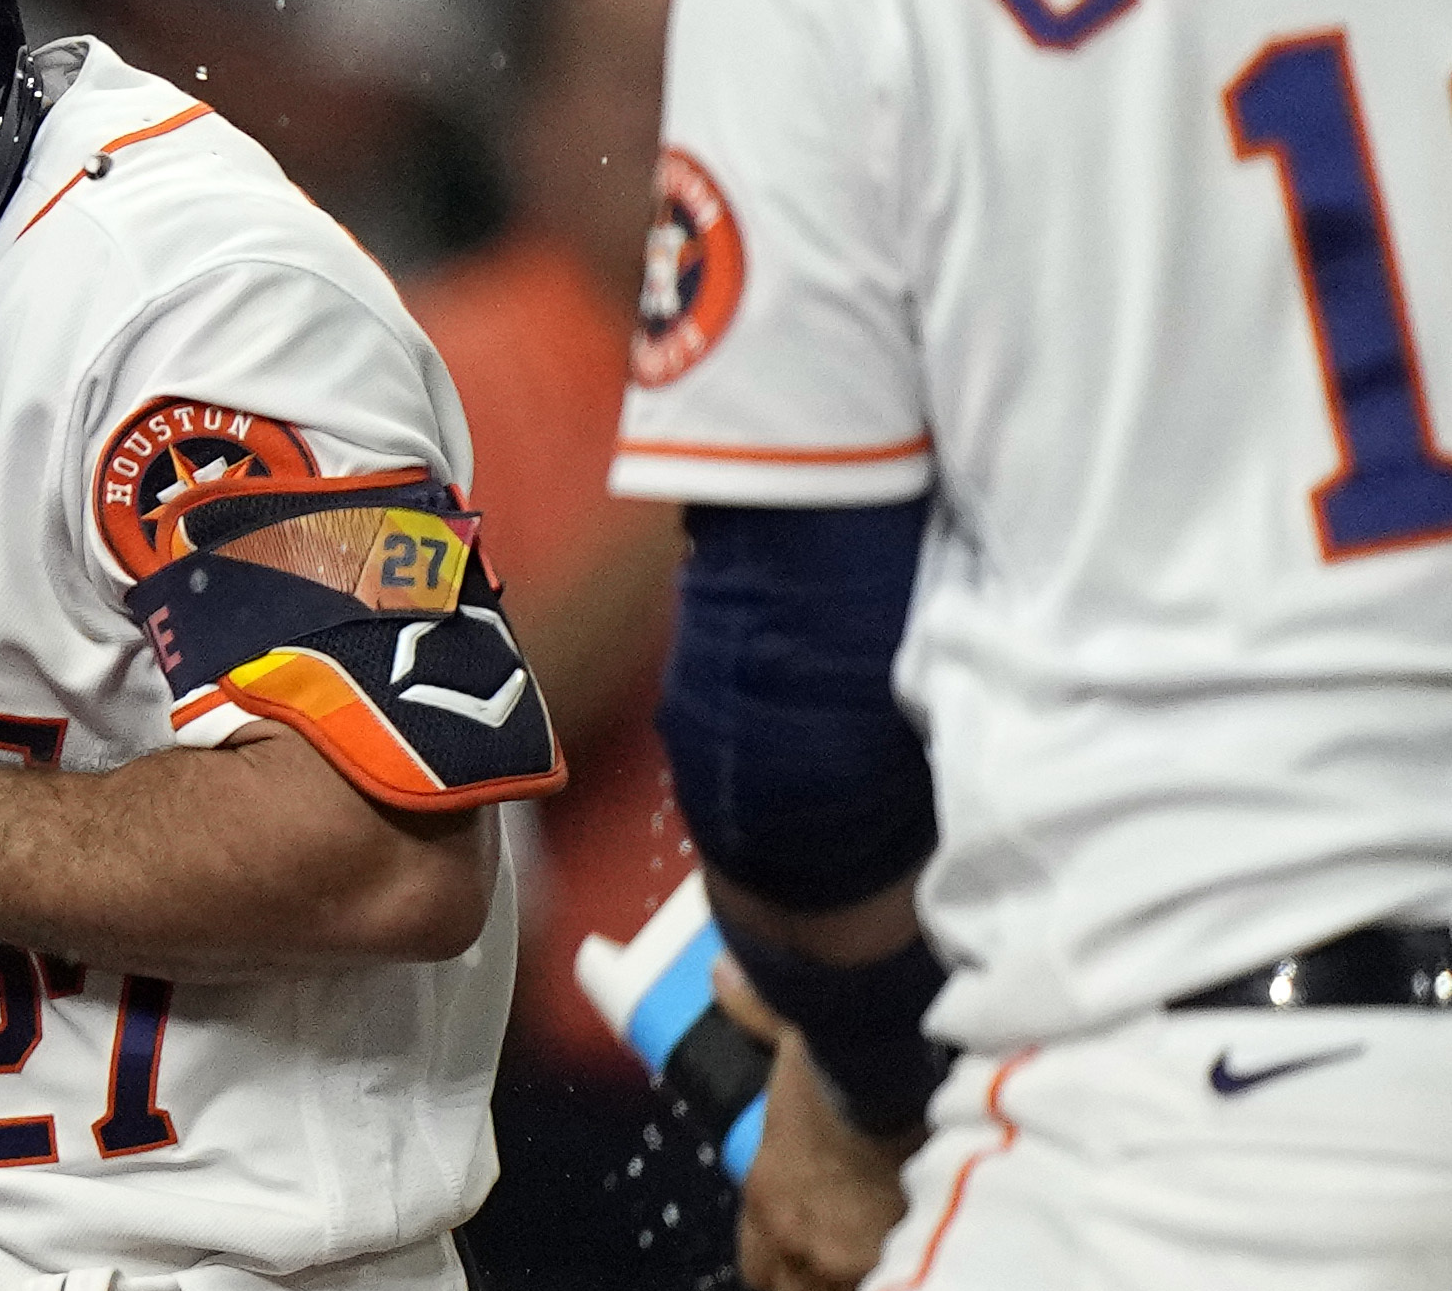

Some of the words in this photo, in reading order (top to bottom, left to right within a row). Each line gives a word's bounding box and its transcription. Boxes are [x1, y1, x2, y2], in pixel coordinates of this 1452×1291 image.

[1220, 22, 1452, 564] 1
[105, 404, 254, 508] HOUSTON
[379, 531, 449, 591] 27
